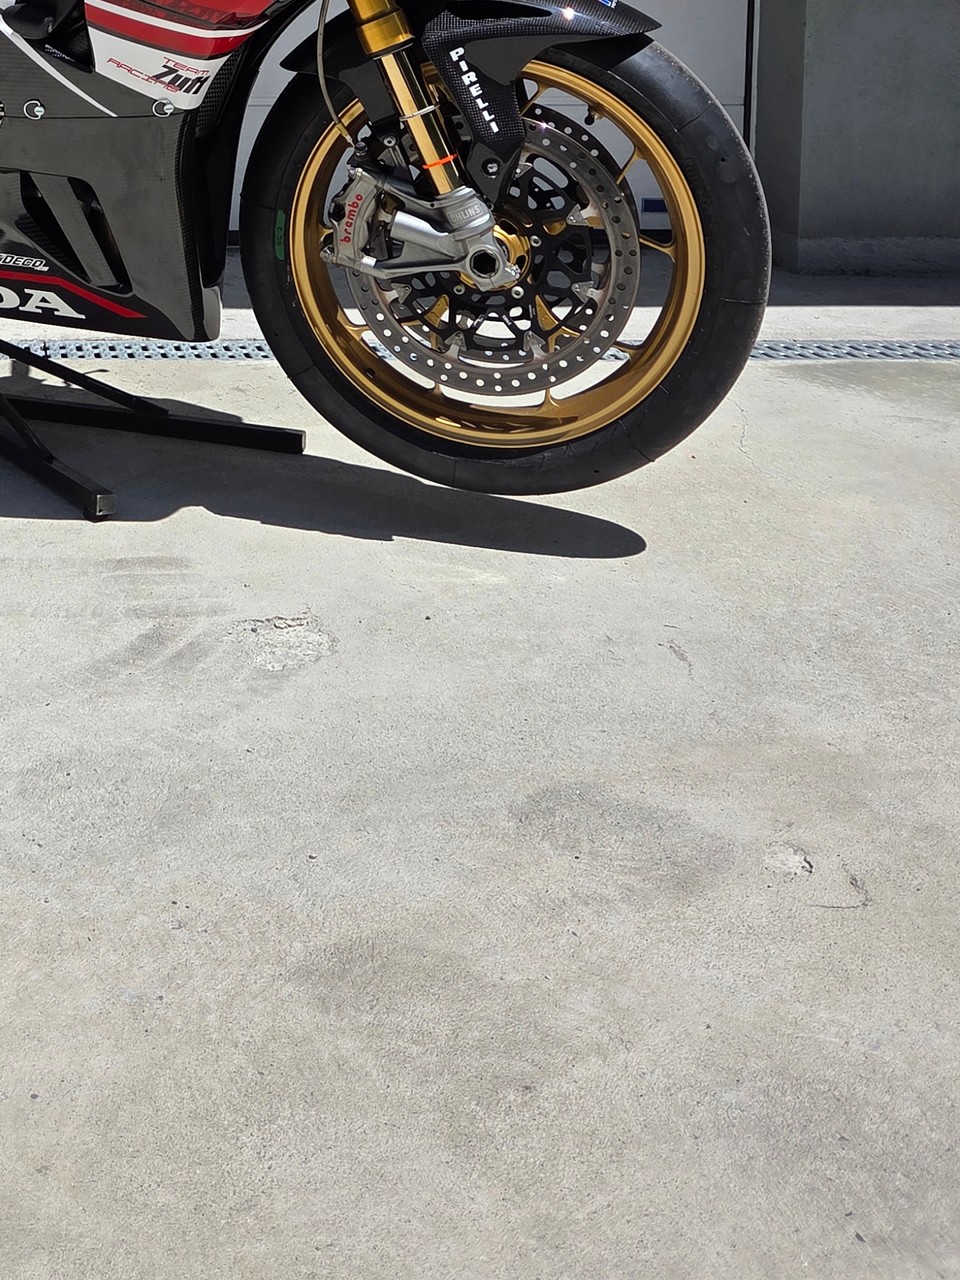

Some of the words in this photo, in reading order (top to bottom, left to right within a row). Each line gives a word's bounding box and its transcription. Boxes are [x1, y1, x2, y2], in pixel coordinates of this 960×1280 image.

[163, 56, 210, 75] TEAM
[449, 46, 499, 133] PIRELLI
[339, 194, 364, 243] brembo
